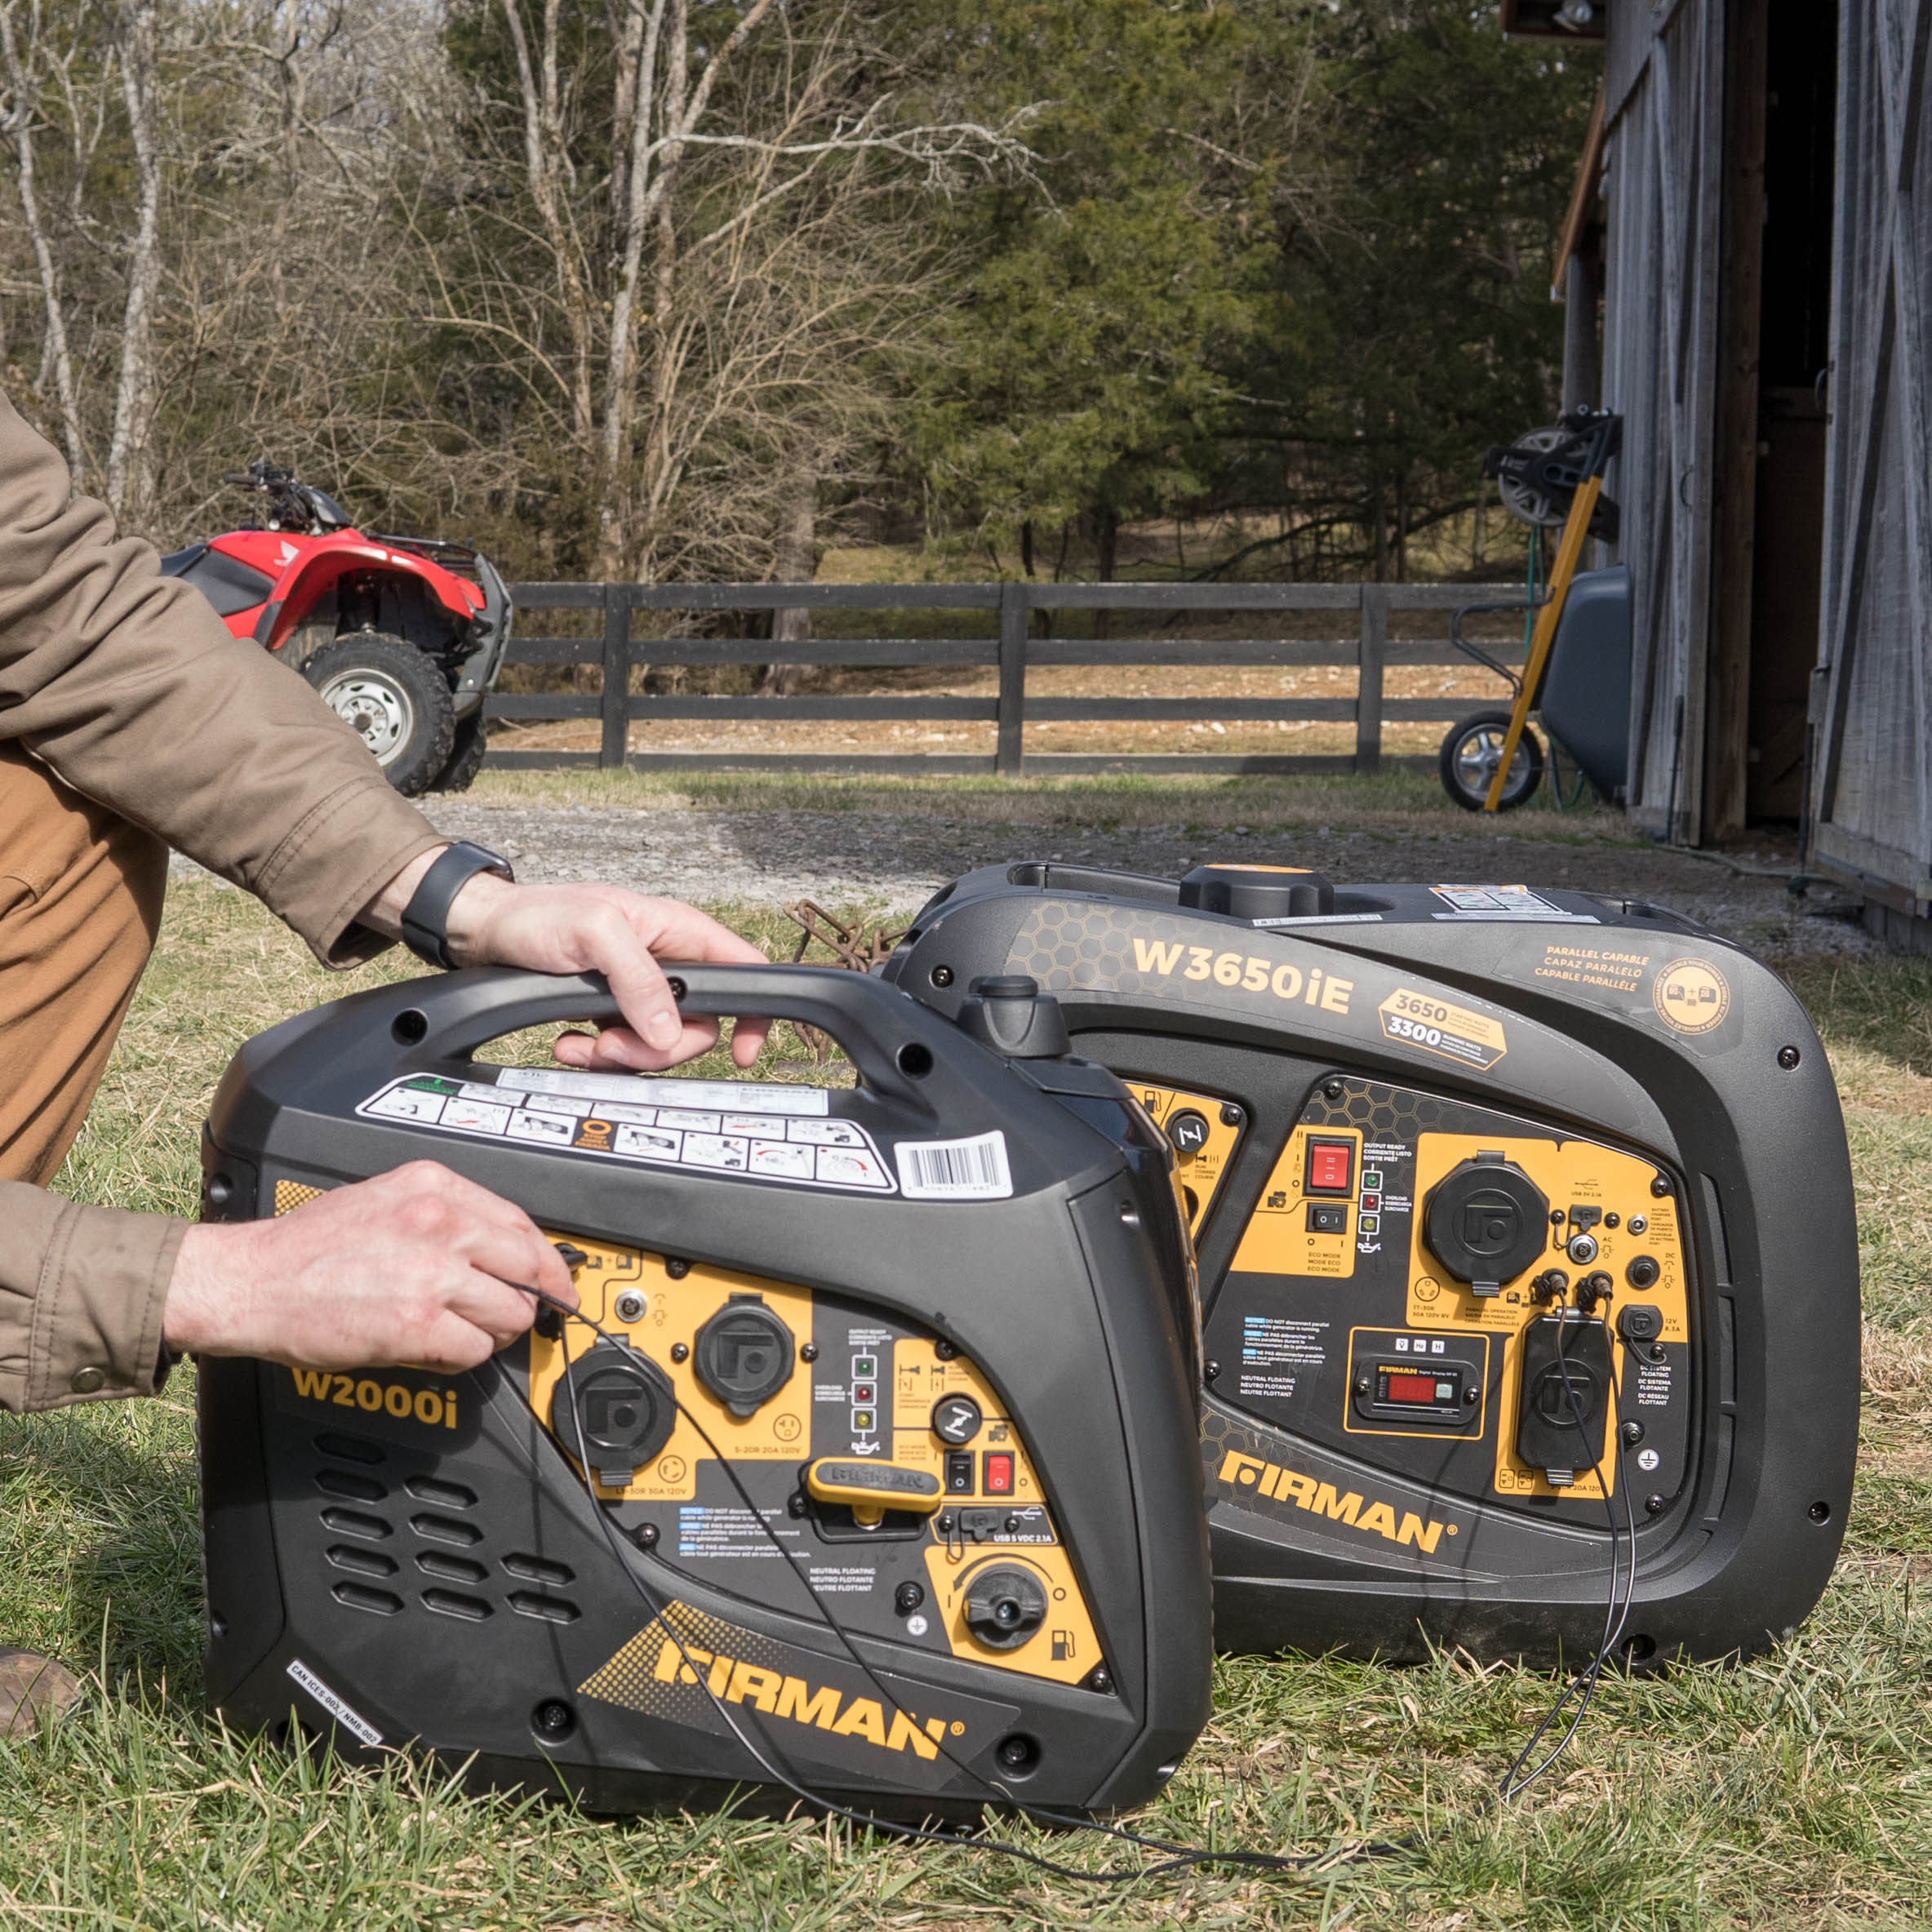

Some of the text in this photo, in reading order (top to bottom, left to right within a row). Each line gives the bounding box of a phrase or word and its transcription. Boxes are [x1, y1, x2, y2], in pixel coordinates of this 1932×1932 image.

[1544, 957, 1642, 978] CAPAZ PARALELO
[1547, 947, 1650, 966] PARALLEL CAPABLE
[1133, 938, 1354, 1015] W3650iE
[1534, 967, 1580, 981] CAPABLE
[1396, 994, 1447, 1022] 3650
[1388, 1015, 1441, 1046] 3300
[1379, 1366, 1417, 1375] FIRMAN
[292, 1368, 458, 1428] W2000i
[1219, 1450, 1444, 1554] FIRMAN
[994, 1534, 1010, 1543] USB
[1018, 1534, 1035, 1543] VDC
[1036, 1534, 1052, 1543] 2.1A
[291, 1666, 308, 1681] CAN
[344, 1713, 378, 1743] NMB-002
[654, 1639, 946, 1761] FIRMAN
